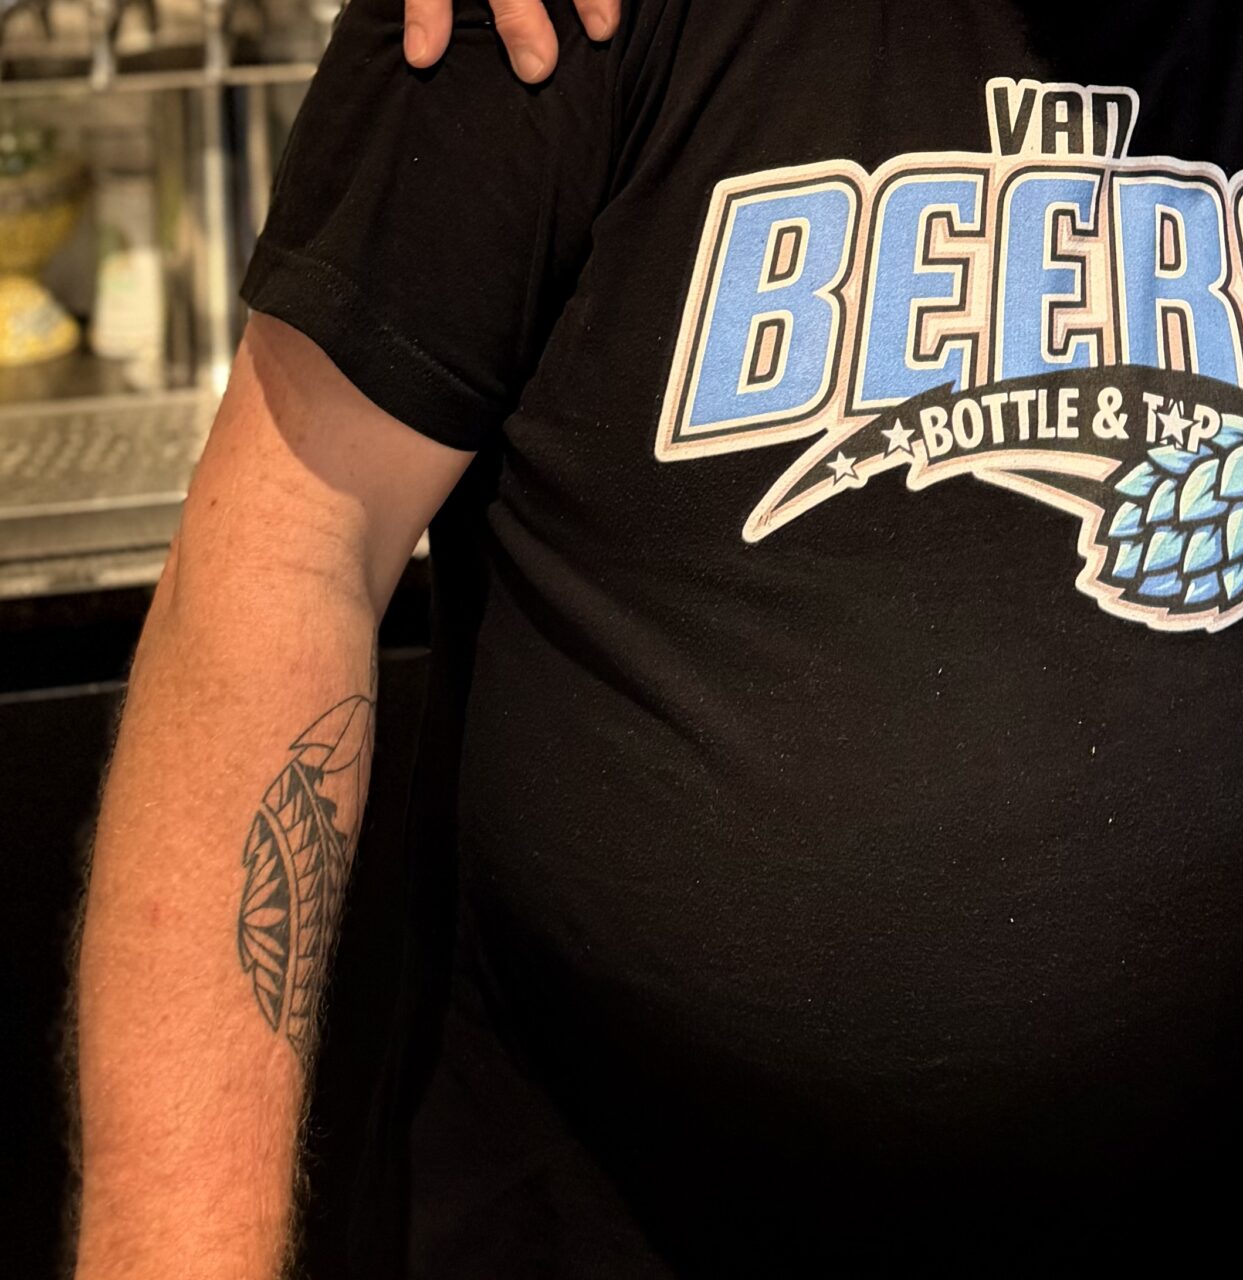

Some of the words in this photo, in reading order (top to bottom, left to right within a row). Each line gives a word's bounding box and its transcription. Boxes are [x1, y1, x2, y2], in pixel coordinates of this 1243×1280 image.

[991, 84, 1135, 160] VAN
[919, 388, 1079, 458] BOTTLE
[1092, 387, 1129, 440] &
